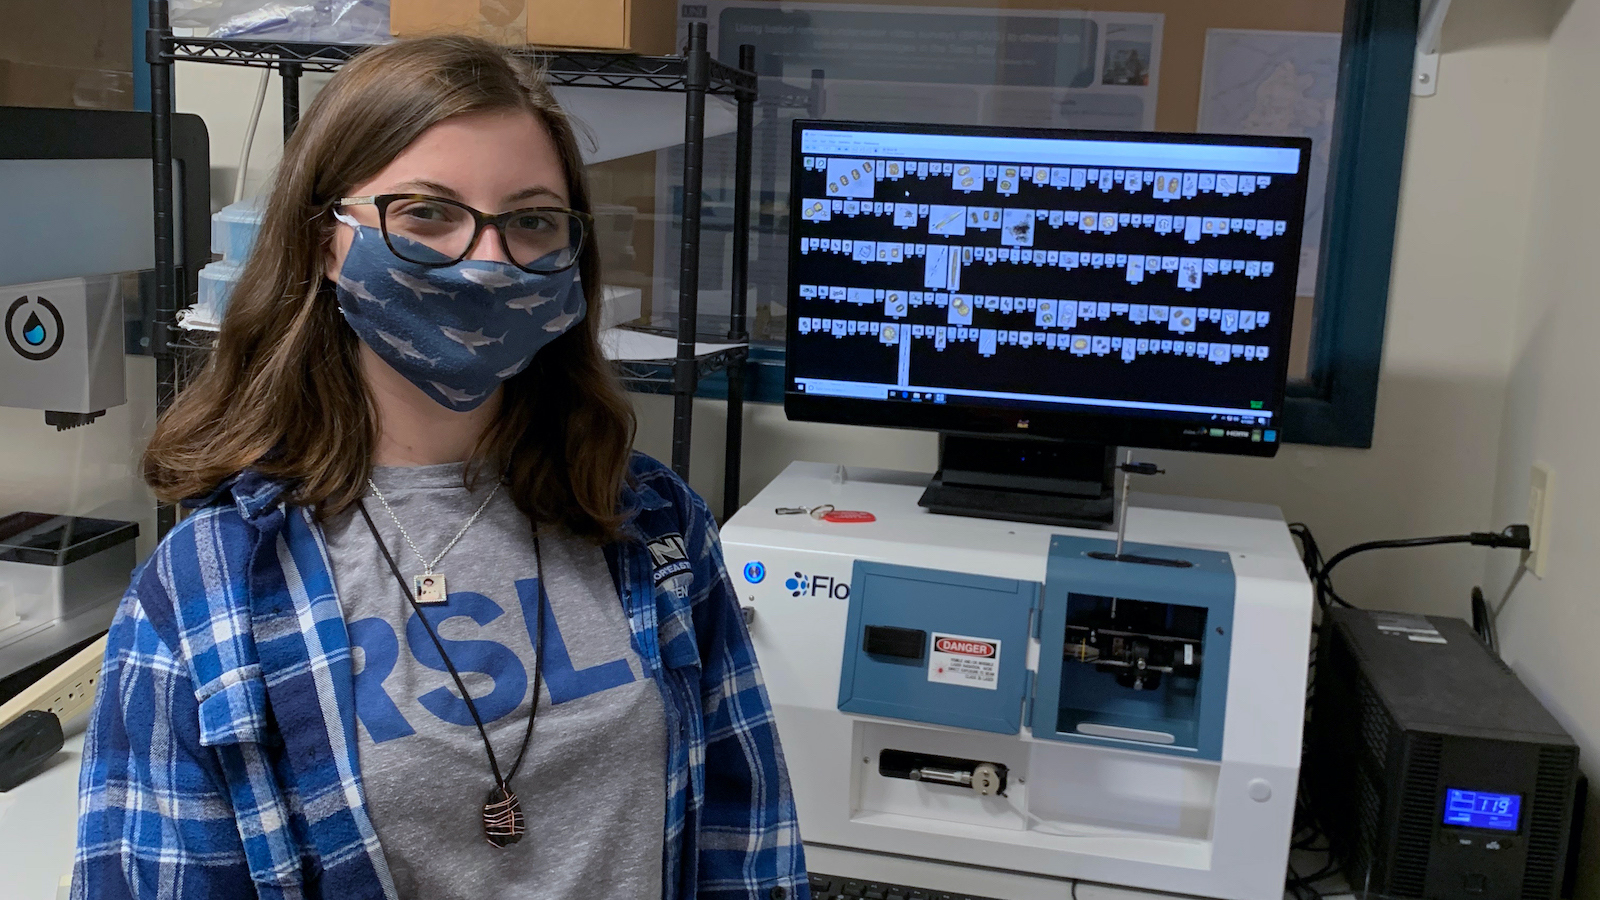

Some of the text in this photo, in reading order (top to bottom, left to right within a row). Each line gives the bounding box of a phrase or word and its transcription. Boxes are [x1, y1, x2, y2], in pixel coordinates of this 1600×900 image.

[735, 23, 762, 35] Using
[811, 575, 850, 600] Flo
[943, 640, 987, 654] DANGER
[347, 577, 652, 744] RSL
[1481, 799, 1509, 814] 119
